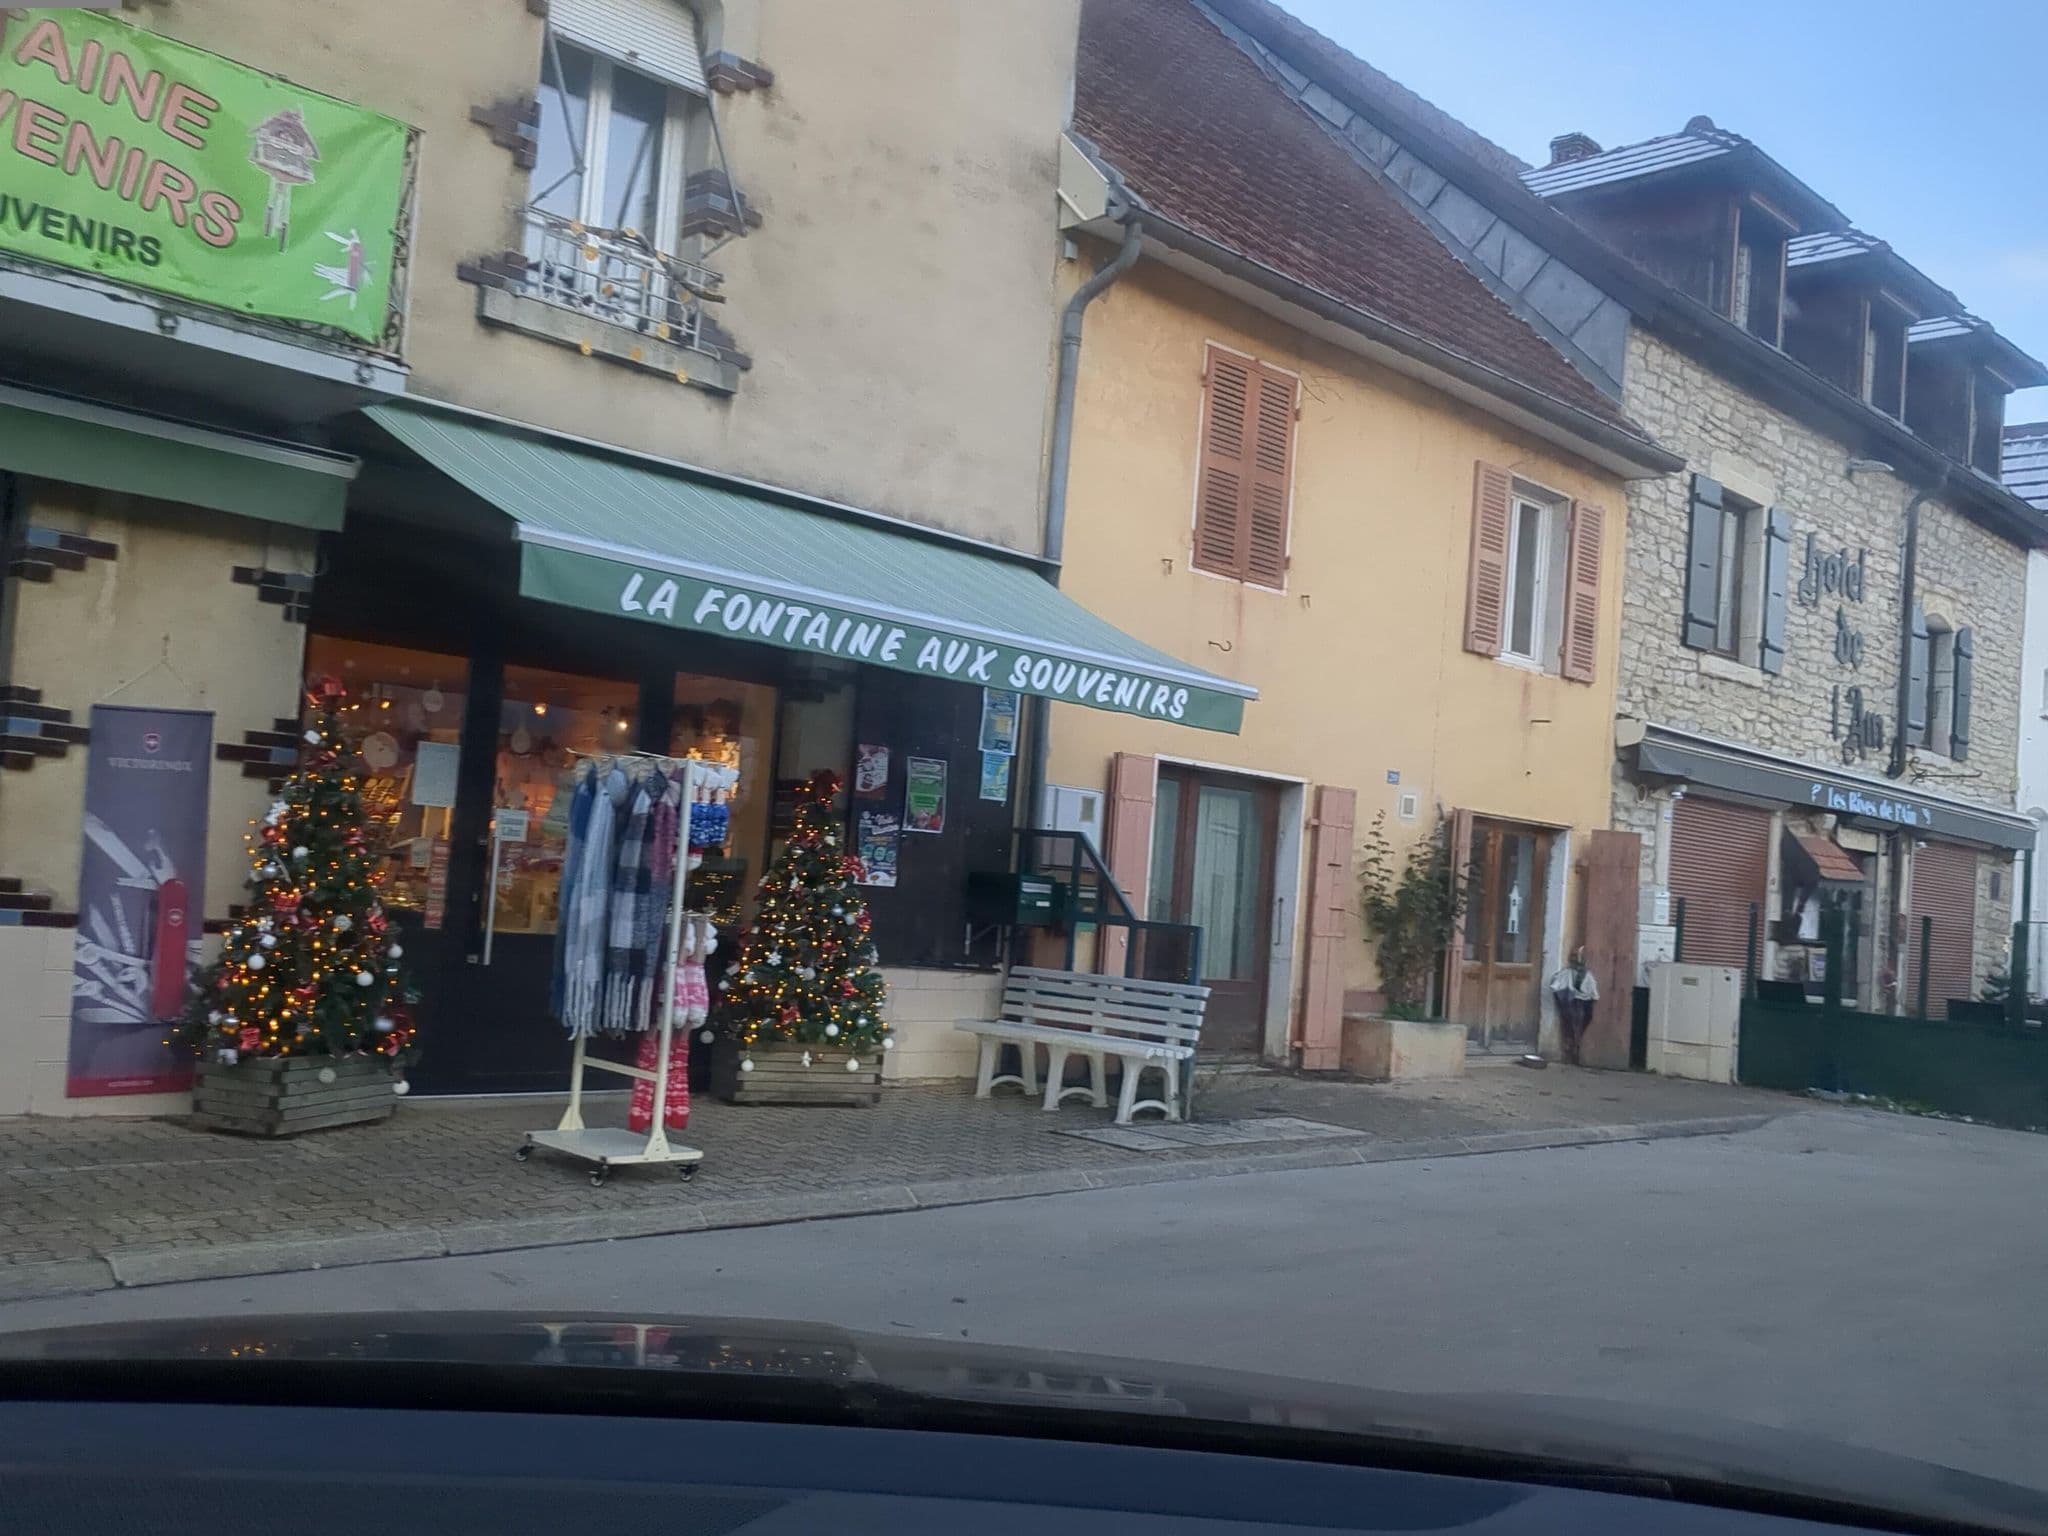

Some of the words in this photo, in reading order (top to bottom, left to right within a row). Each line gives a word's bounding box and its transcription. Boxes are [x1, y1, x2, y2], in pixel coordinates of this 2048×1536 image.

[620, 573, 680, 619] LA
[693, 588, 907, 662] FONTAINE
[916, 636, 998, 681] AUX
[1008, 655, 1189, 719] SOUVENIRS
